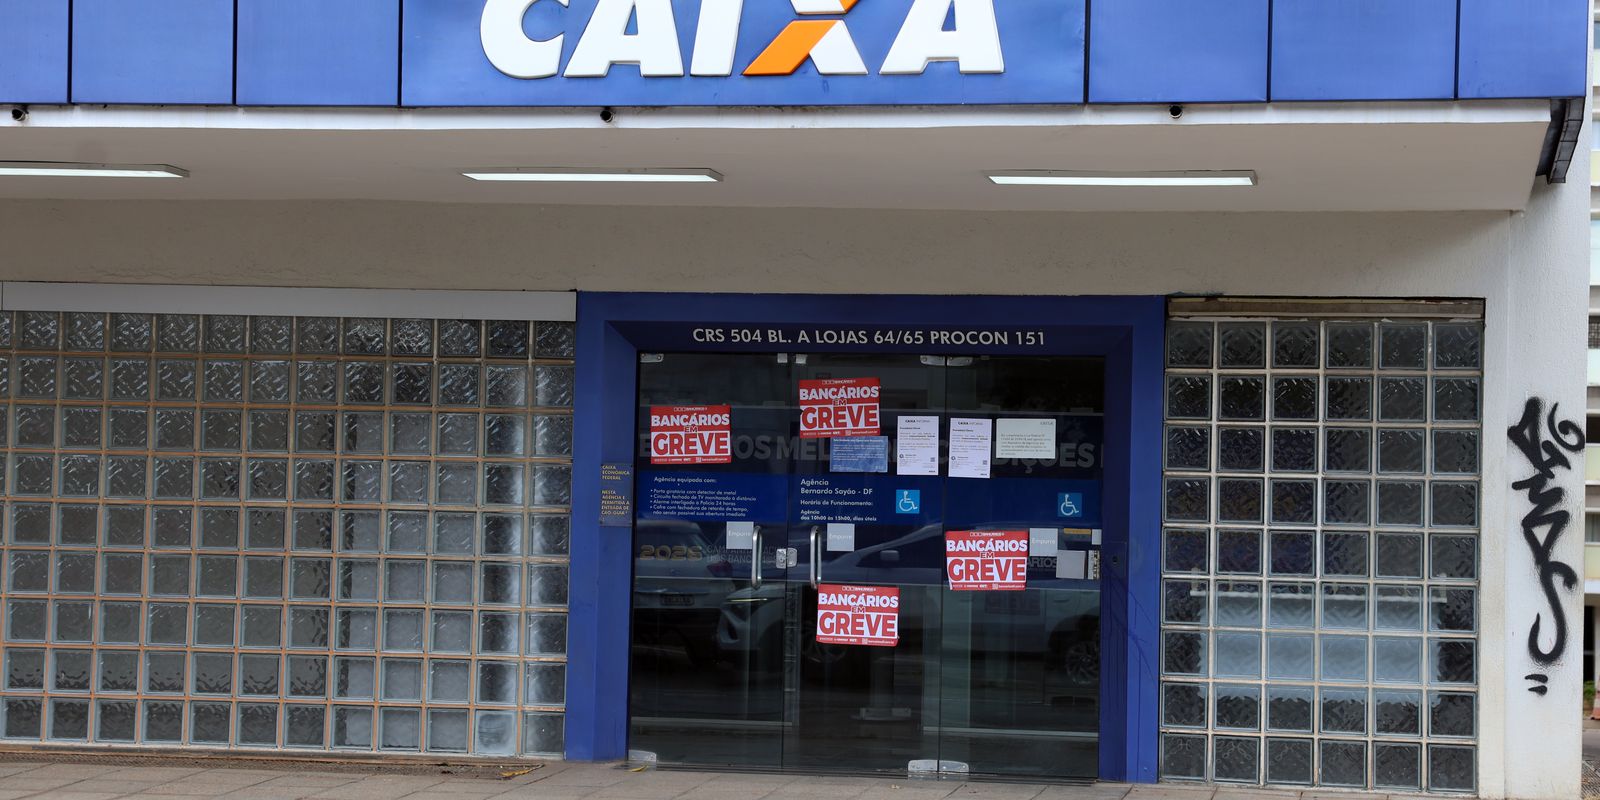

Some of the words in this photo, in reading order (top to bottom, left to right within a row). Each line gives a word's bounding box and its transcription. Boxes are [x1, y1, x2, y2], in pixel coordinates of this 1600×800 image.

[481, 0, 1005, 79] CAIXA
[693, 328, 725, 342] CRS
[731, 329, 762, 343] 504
[767, 329, 792, 343] BL.
[797, 330, 811, 343] A
[815, 330, 868, 344] LOJAS
[874, 330, 924, 345] 64/65
[930, 330, 1008, 345] PROCON
[1015, 331, 1044, 345] 151
[800, 386, 880, 400] BANCÁRIOS
[651, 413, 730, 427] BANCÁRIOS
[802, 405, 878, 429] GREVE
[653, 433, 729, 455] GREVE
[800, 478, 829, 487] Agência
[800, 487, 833, 495] Bernardo
[834, 487, 856, 496] Sayão
[946, 538, 1028, 552] BANCÁRIOS
[948, 559, 1025, 581] GREVE
[818, 593, 899, 608] BANCÁRIOS
[819, 612, 896, 637] GREVE
